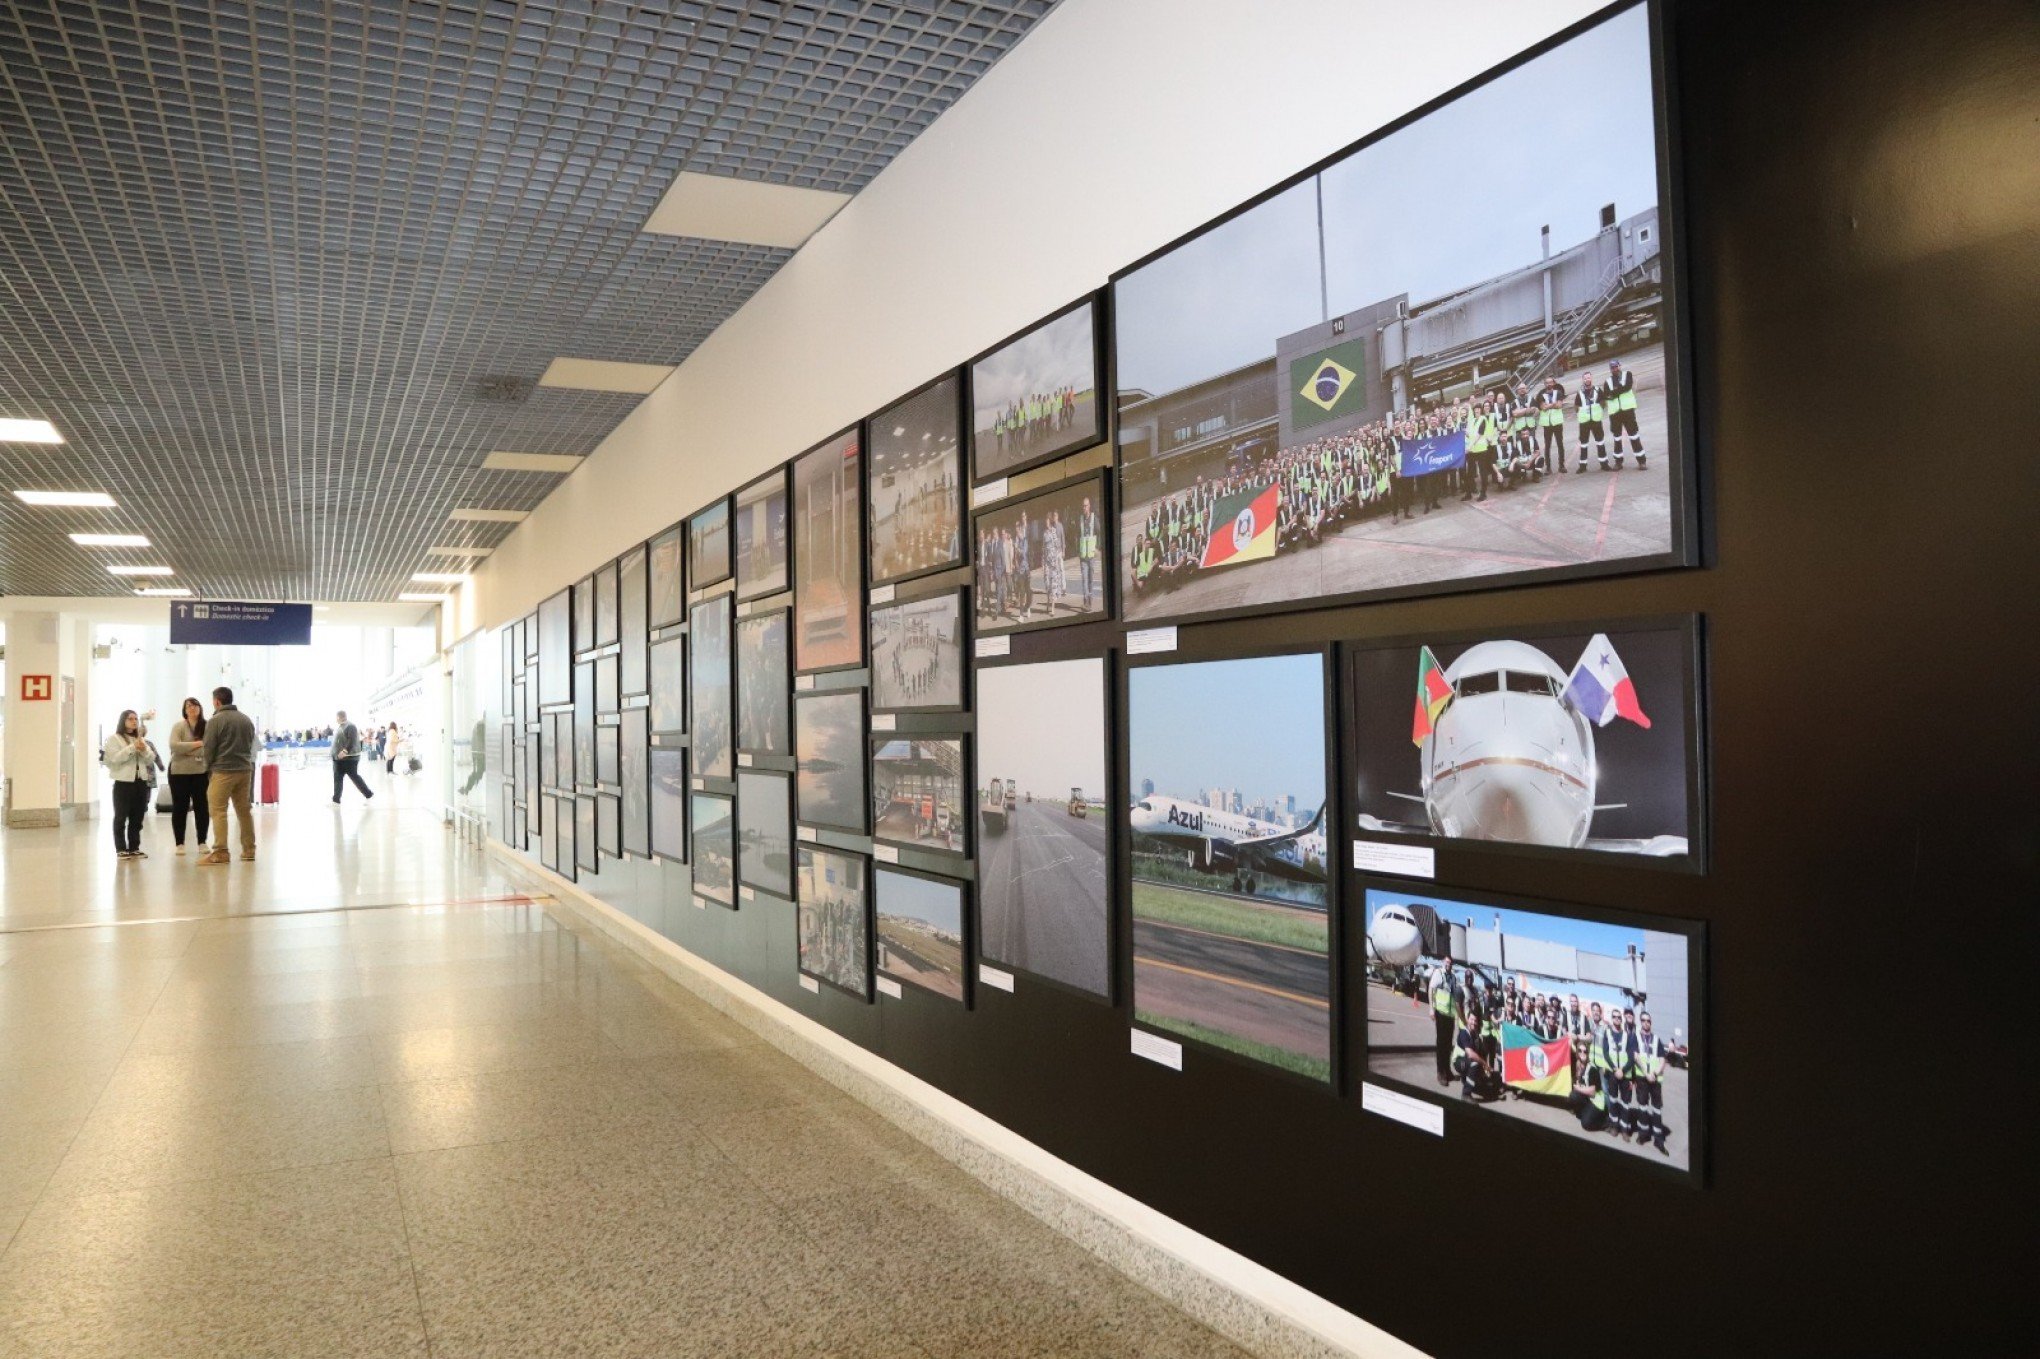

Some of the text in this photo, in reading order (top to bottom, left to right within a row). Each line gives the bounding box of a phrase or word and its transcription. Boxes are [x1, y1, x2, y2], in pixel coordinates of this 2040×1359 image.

[1333, 320, 1344, 332] 10
[212, 604, 241, 612] Check-in
[25, 678, 48, 697] H
[1168, 804, 1203, 832] Azul
